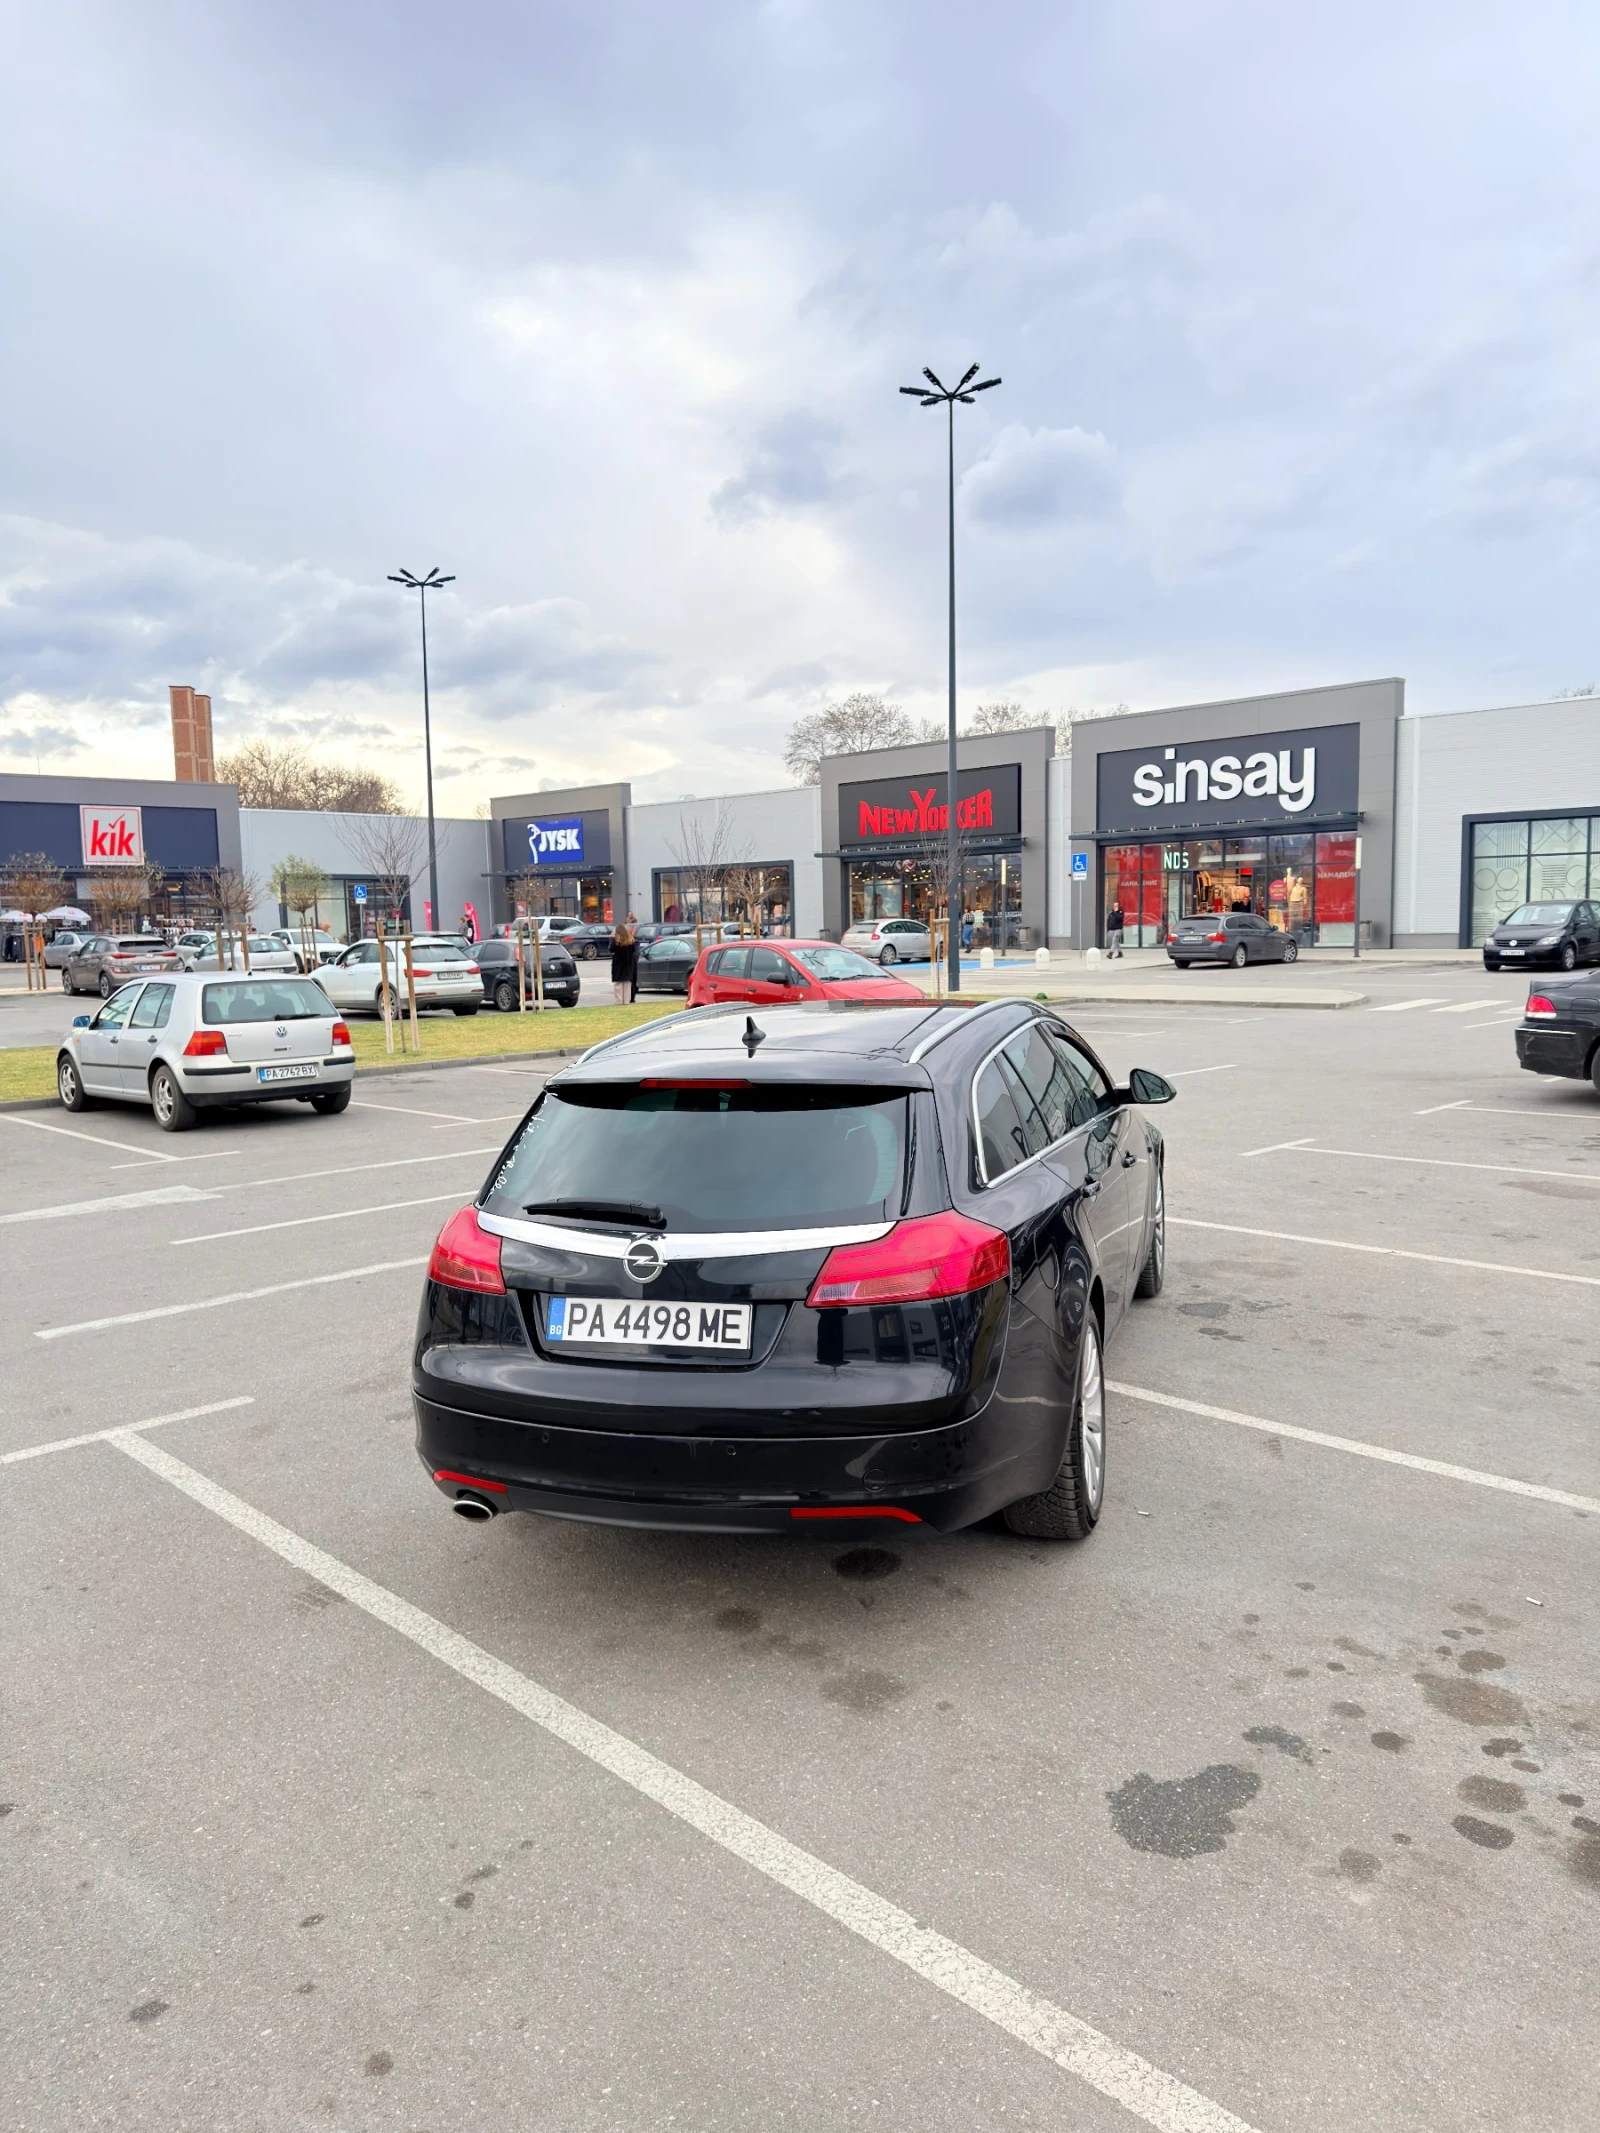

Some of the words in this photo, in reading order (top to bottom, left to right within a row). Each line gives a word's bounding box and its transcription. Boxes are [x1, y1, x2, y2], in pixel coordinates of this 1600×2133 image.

[1132, 747, 1316, 812] sinsay
[538, 828, 581, 852] JYSK
[1163, 851, 1190, 870] NDS
[549, 1325, 563, 1336] BG
[567, 1303, 605, 1338] PA
[613, 1304, 691, 1341] 4498
[698, 1308, 743, 1345] ME
